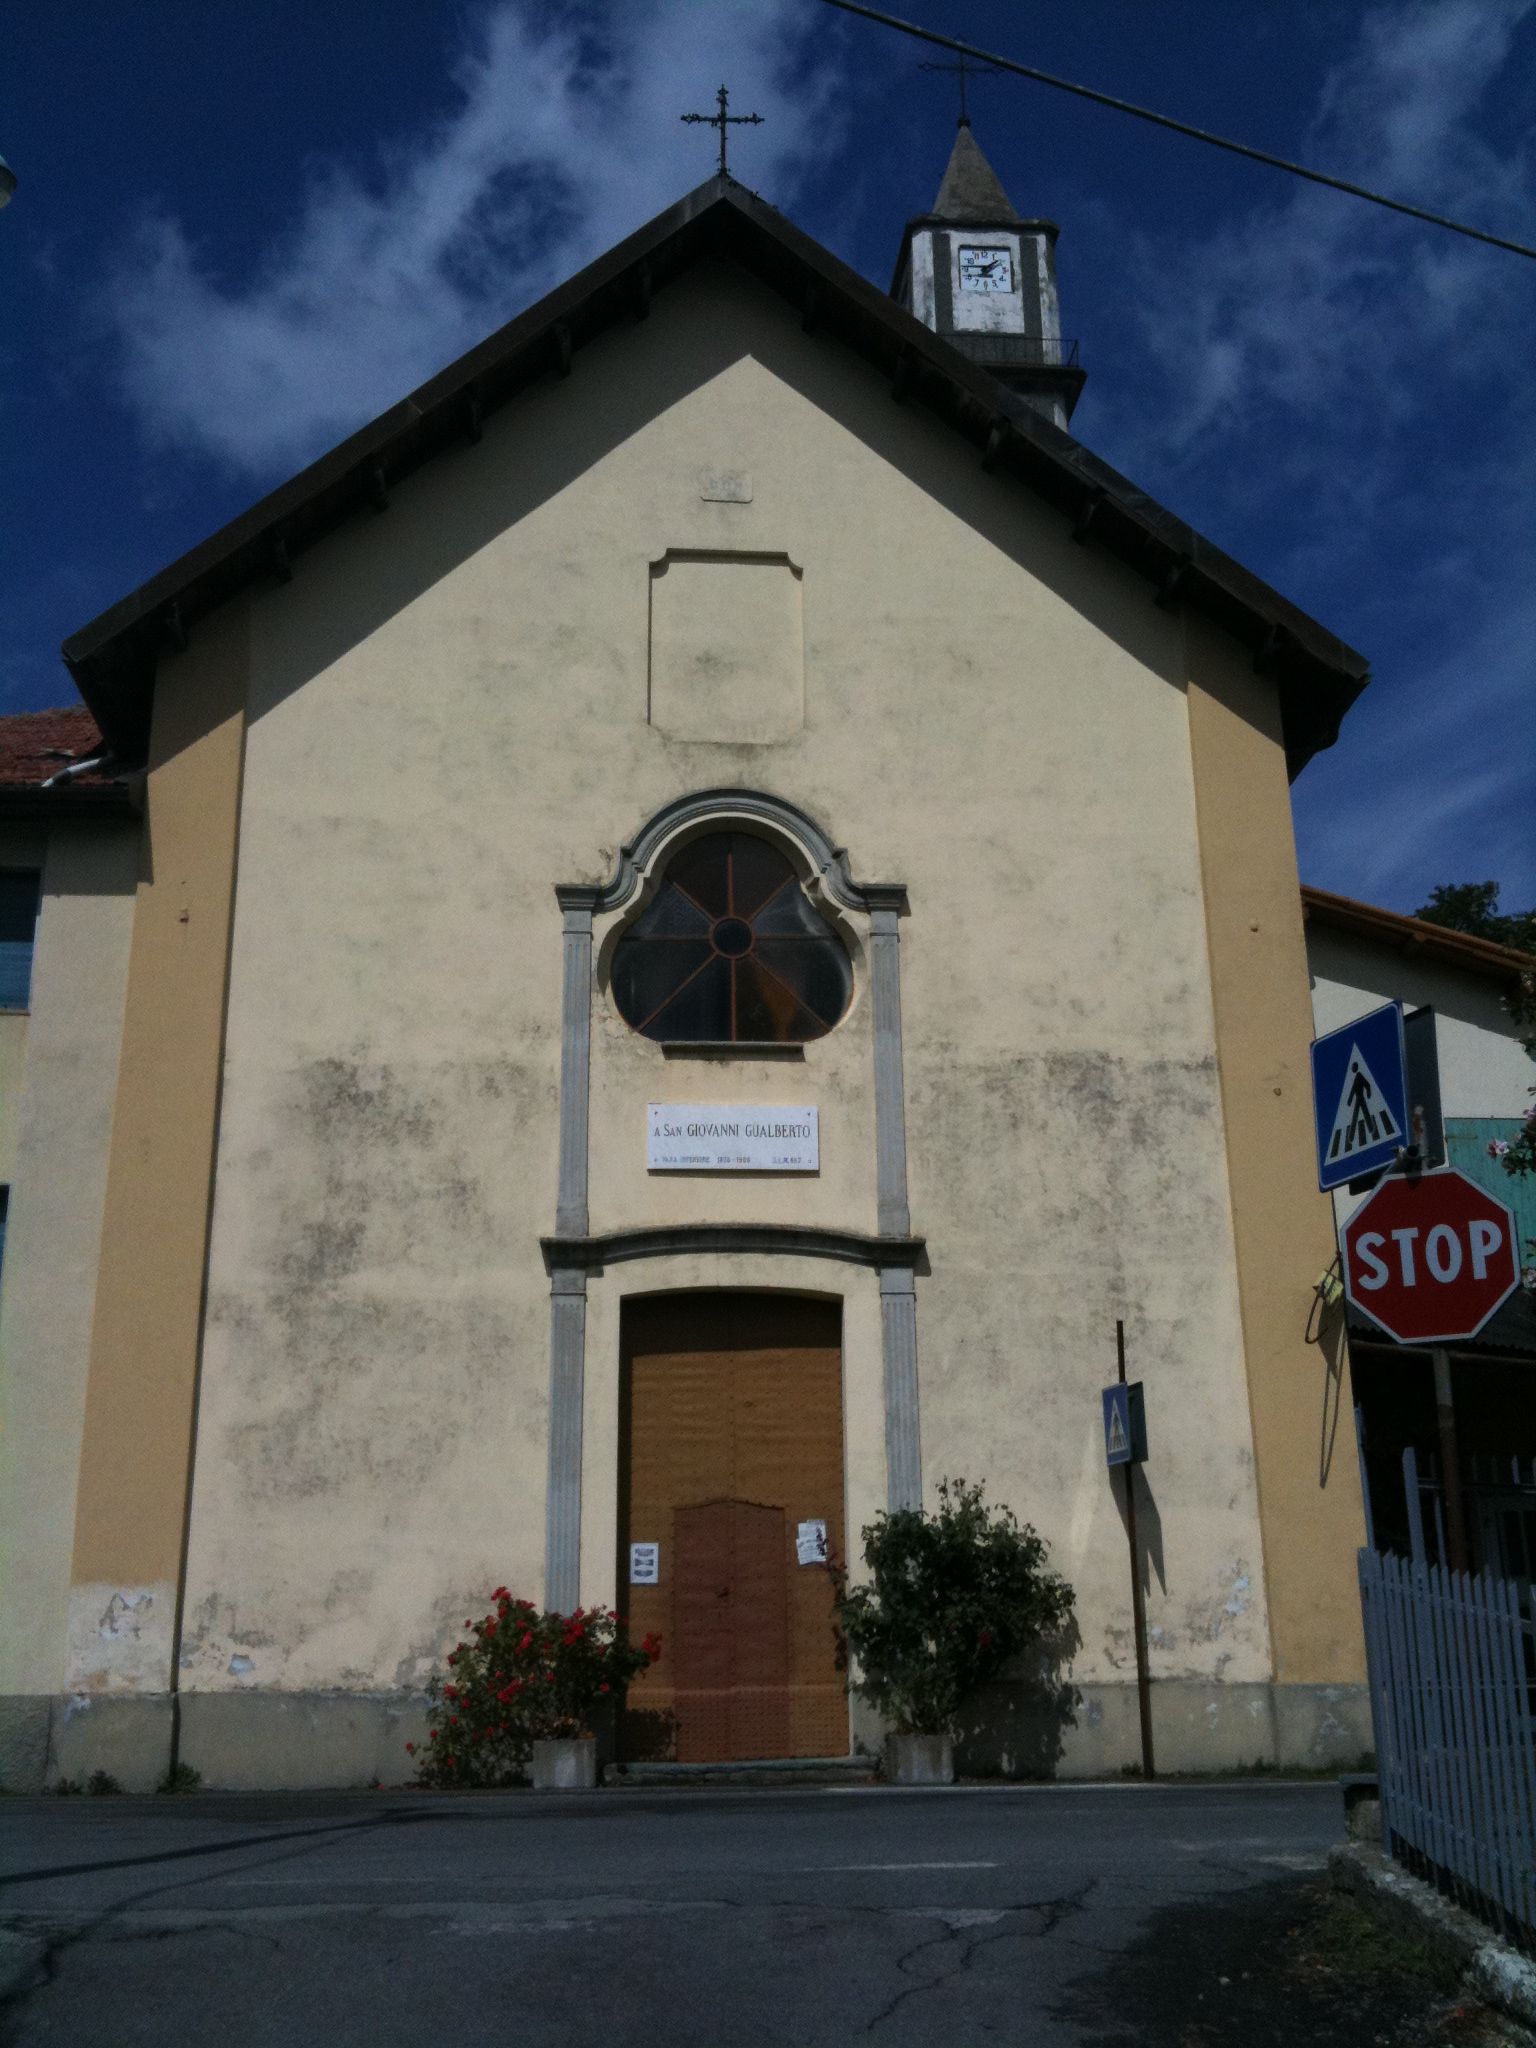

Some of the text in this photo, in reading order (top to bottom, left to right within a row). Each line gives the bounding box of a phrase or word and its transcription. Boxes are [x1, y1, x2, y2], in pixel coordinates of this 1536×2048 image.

[974, 279, 979, 287] 7
[654, 1127, 660, 1136] A
[687, 1124, 739, 1137] GIOVANNI
[745, 1124, 811, 1138] GUALBERTO
[1355, 1219, 1503, 1290] STOP
